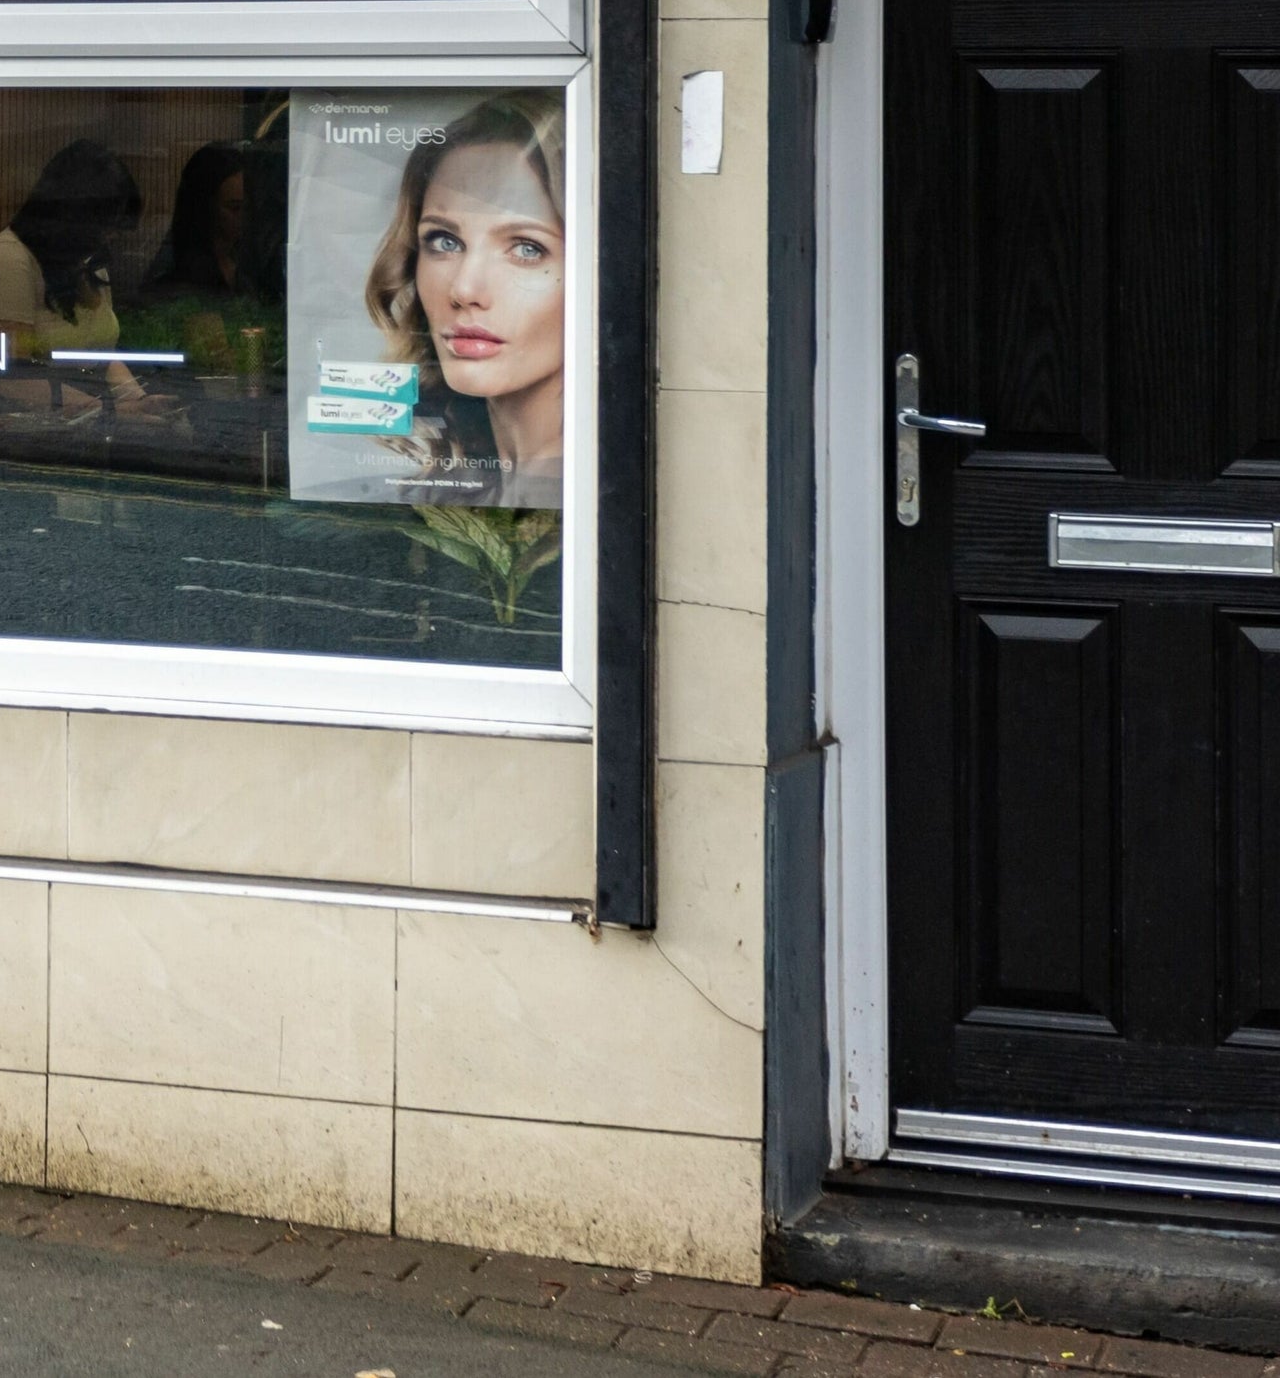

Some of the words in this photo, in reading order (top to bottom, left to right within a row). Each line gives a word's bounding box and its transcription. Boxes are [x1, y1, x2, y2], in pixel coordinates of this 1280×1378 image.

[325, 120, 381, 144] lumi
[385, 126, 447, 151] eyes
[355, 453, 419, 468] Ultimate
[423, 454, 513, 472] Brightening
